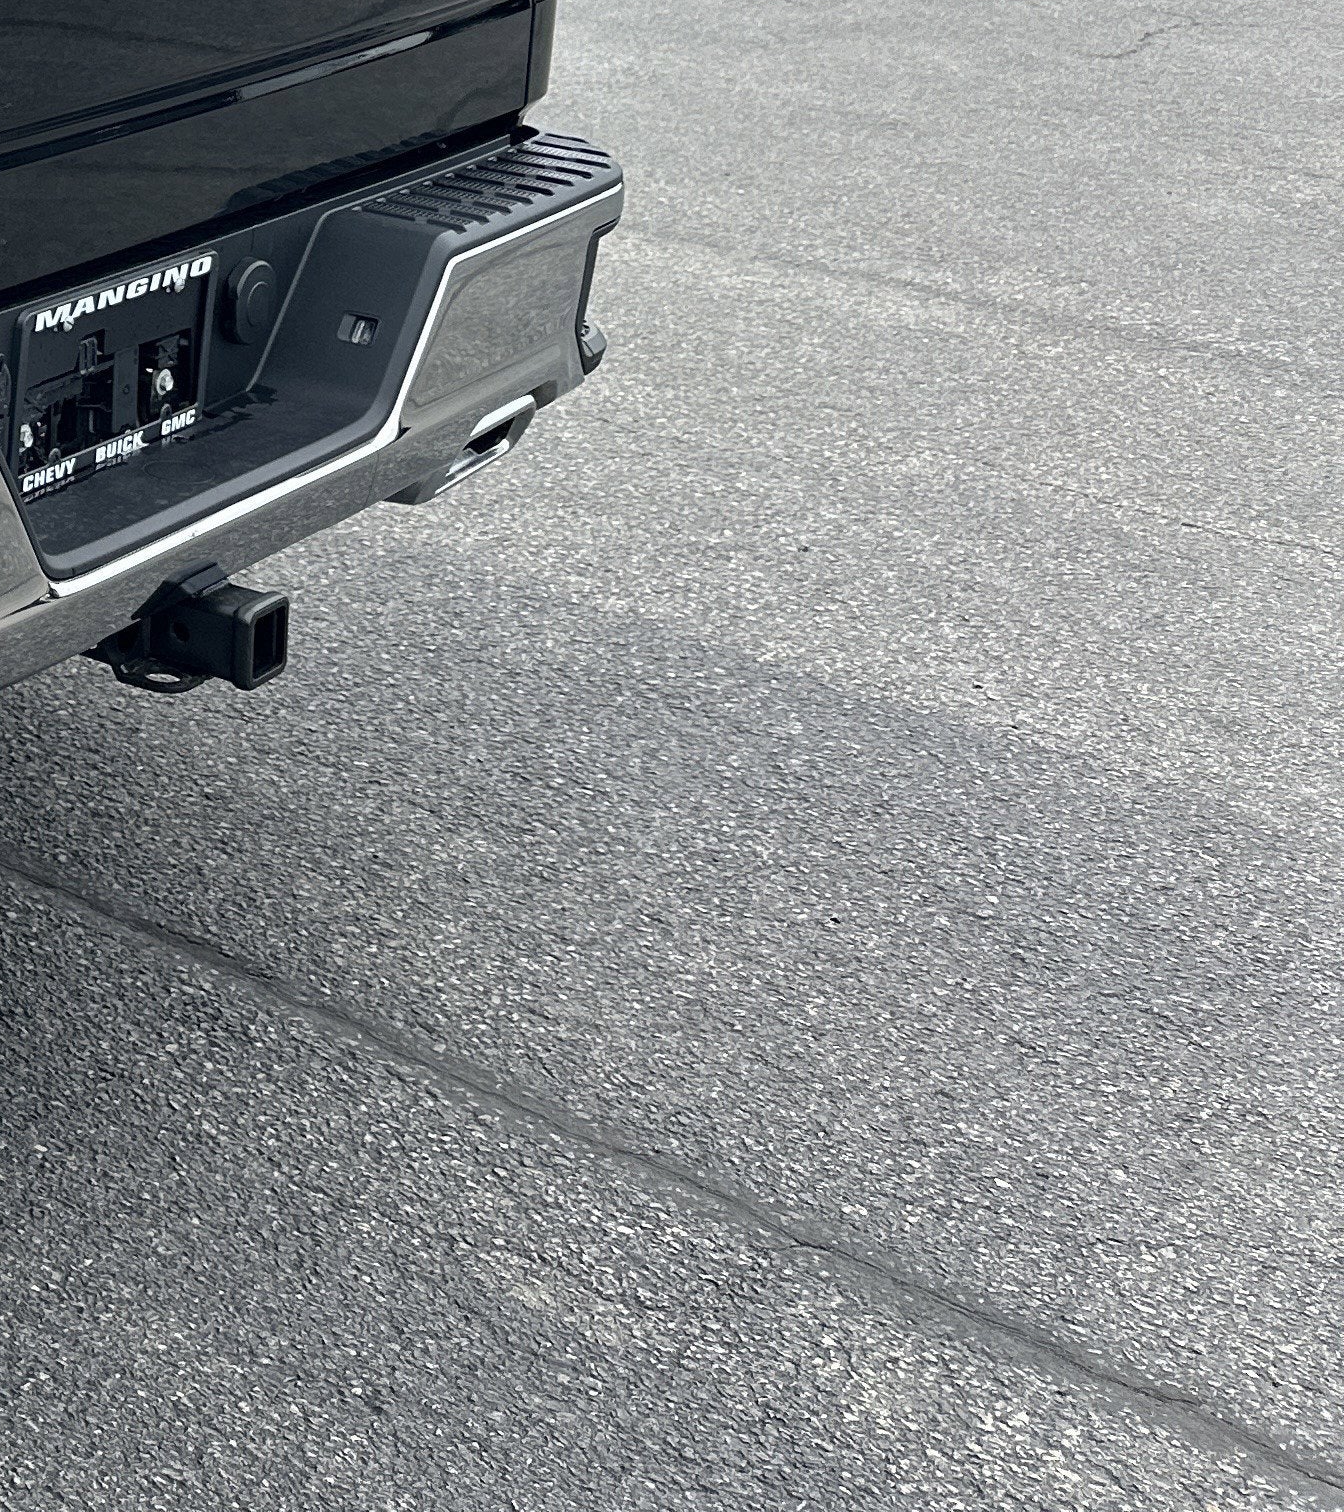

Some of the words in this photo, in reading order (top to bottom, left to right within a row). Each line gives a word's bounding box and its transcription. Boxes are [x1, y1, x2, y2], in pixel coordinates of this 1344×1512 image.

[34, 255, 212, 332] MANGINO
[22, 457, 76, 493] CHEVY
[95, 430, 144, 463] BUICK
[161, 408, 196, 436] GMC
